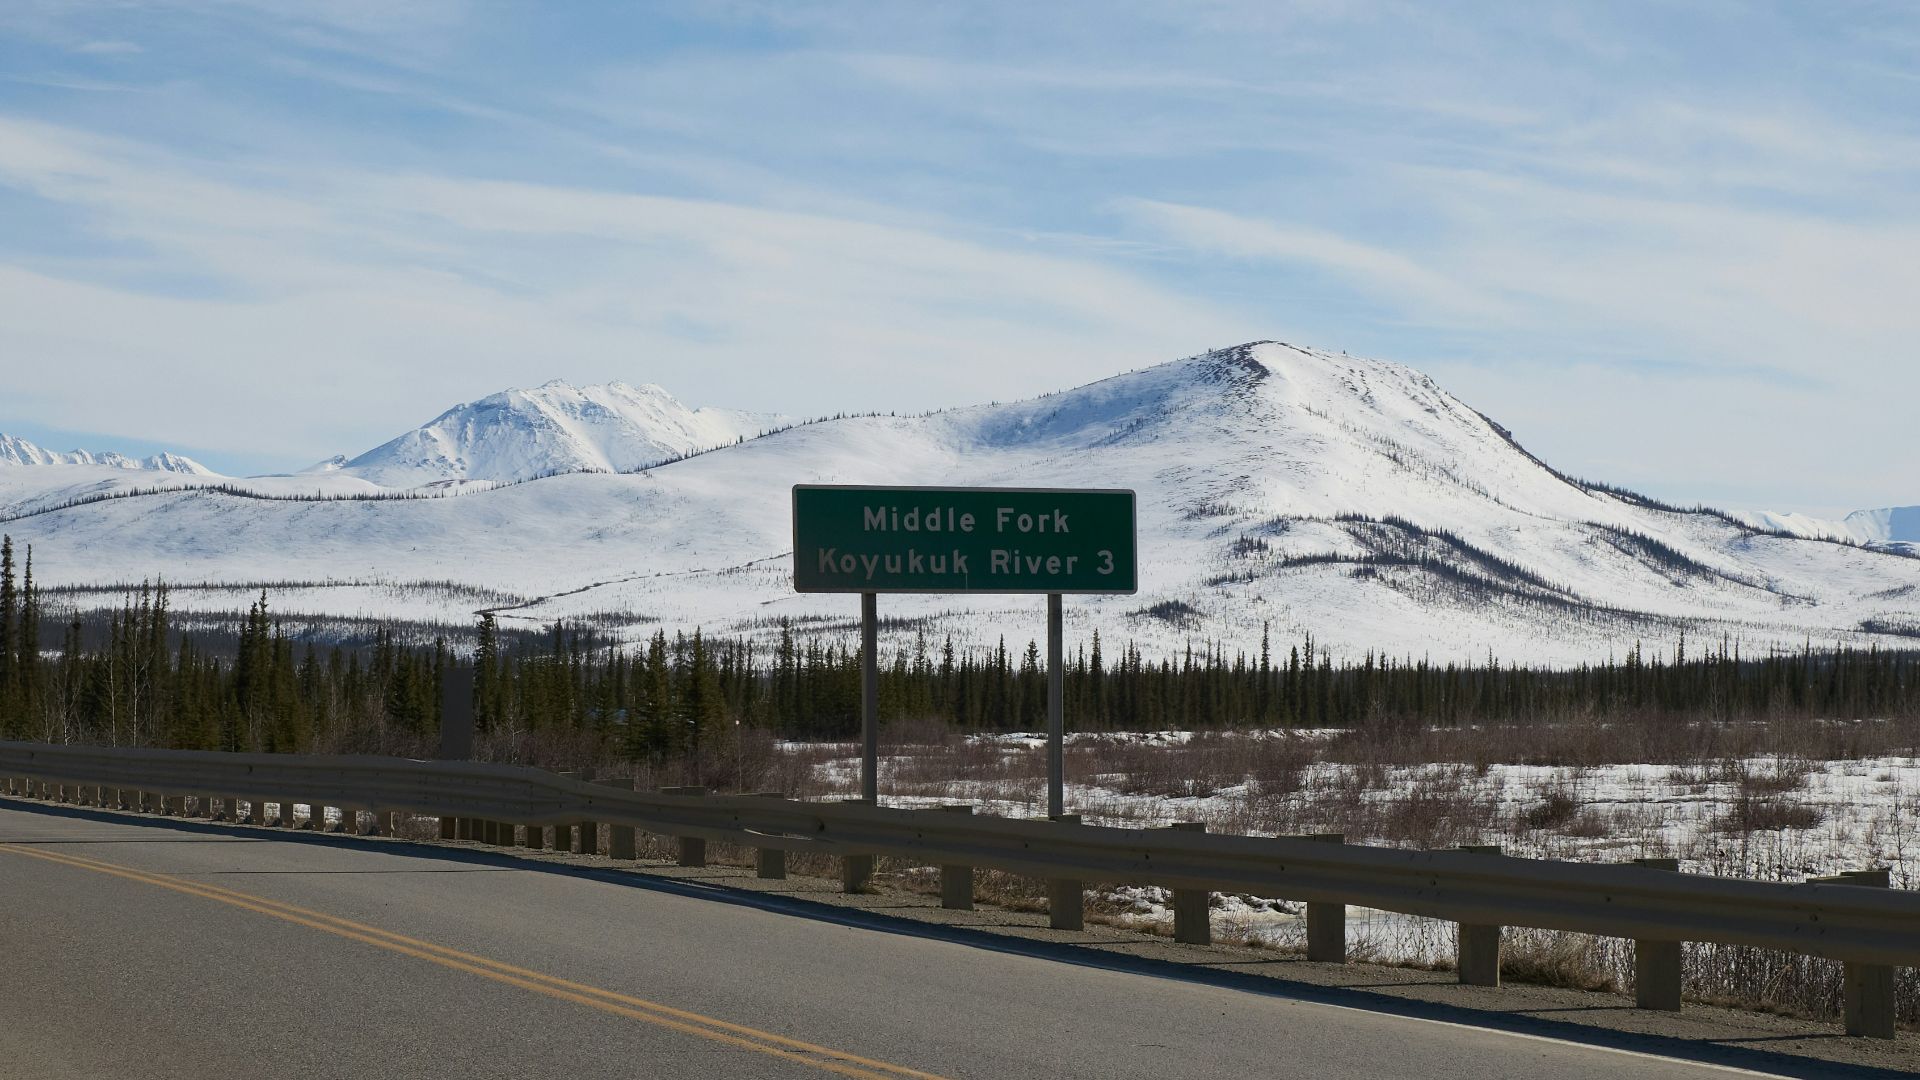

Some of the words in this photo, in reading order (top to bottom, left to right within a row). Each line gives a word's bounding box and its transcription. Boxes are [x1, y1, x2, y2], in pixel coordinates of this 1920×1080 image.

[863, 506, 976, 532] Middle
[996, 507, 1070, 533] Fork
[818, 548, 969, 580] Koyukuk
[990, 549, 1079, 575] River
[1096, 550, 1116, 576] 3
